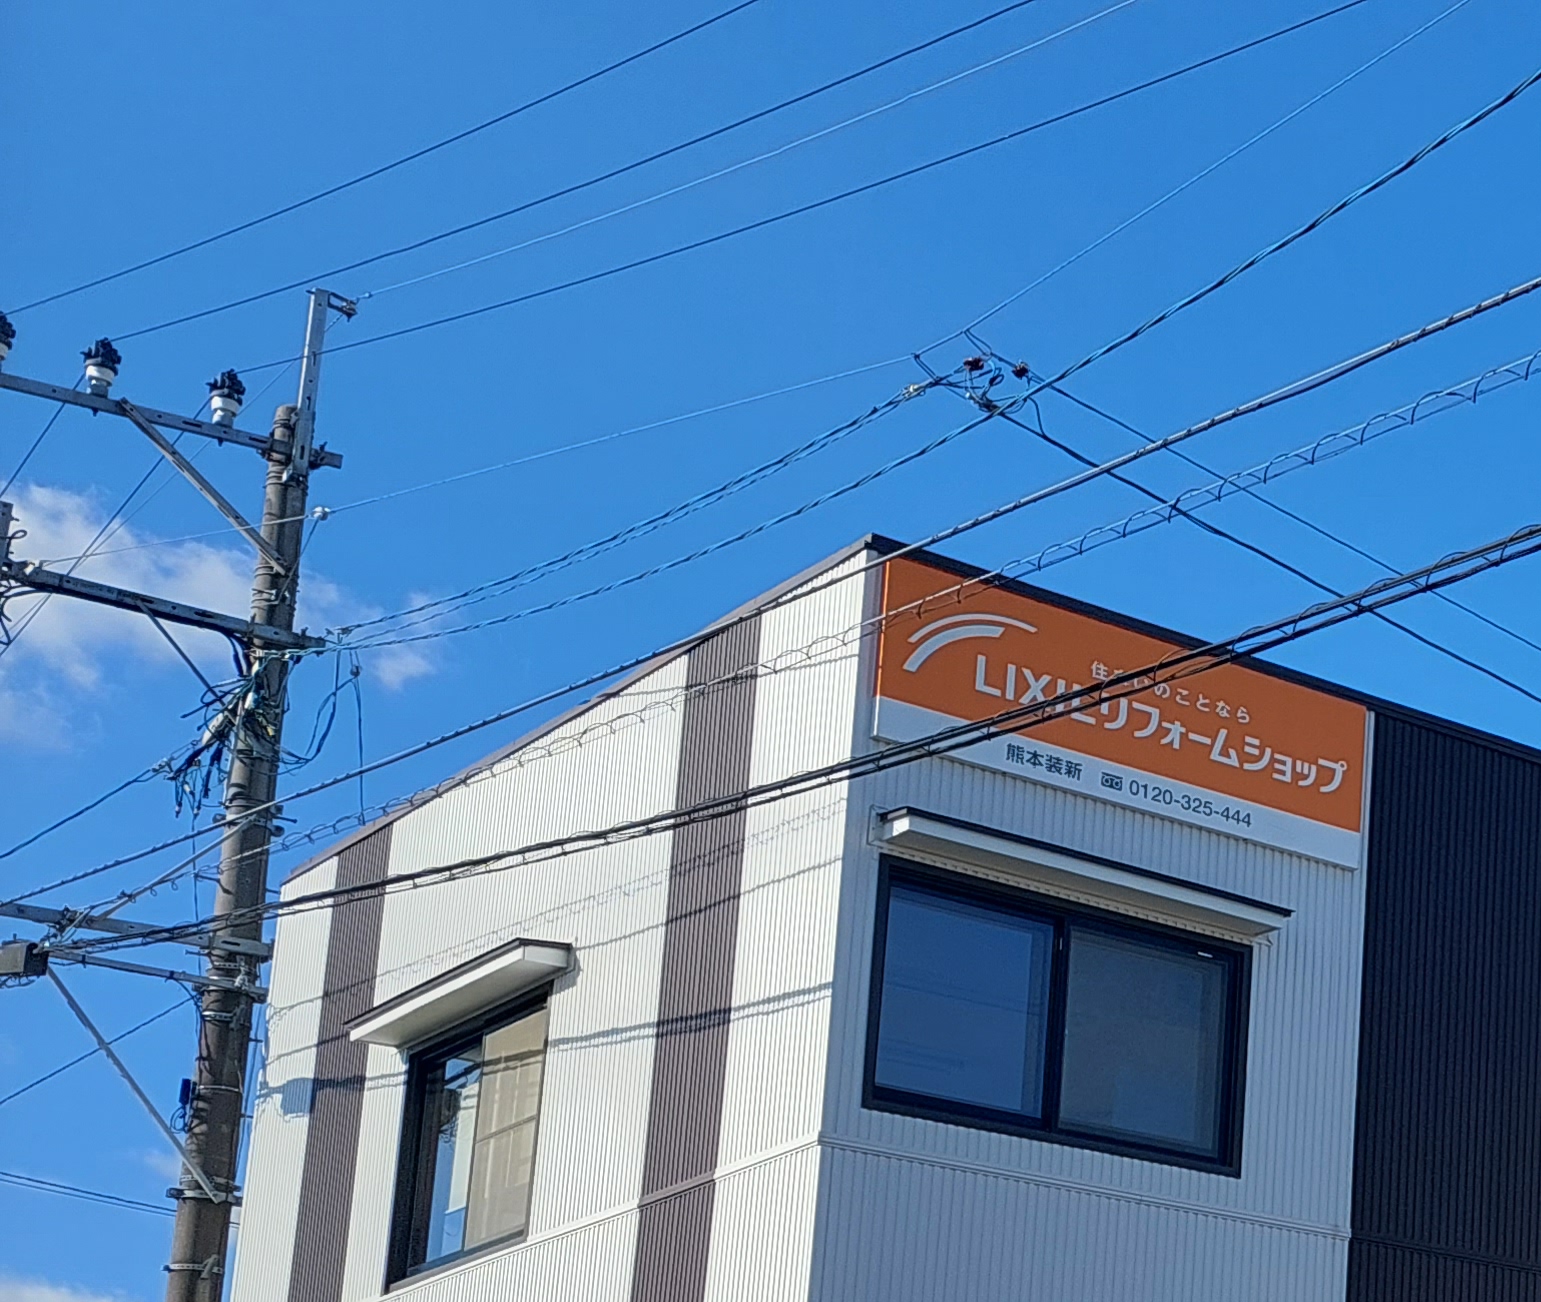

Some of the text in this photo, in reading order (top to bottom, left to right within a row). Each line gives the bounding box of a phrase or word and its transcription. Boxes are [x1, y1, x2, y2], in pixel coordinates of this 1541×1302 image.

[1005, 742, 1253, 828] 熊本装新 0120-325-444
